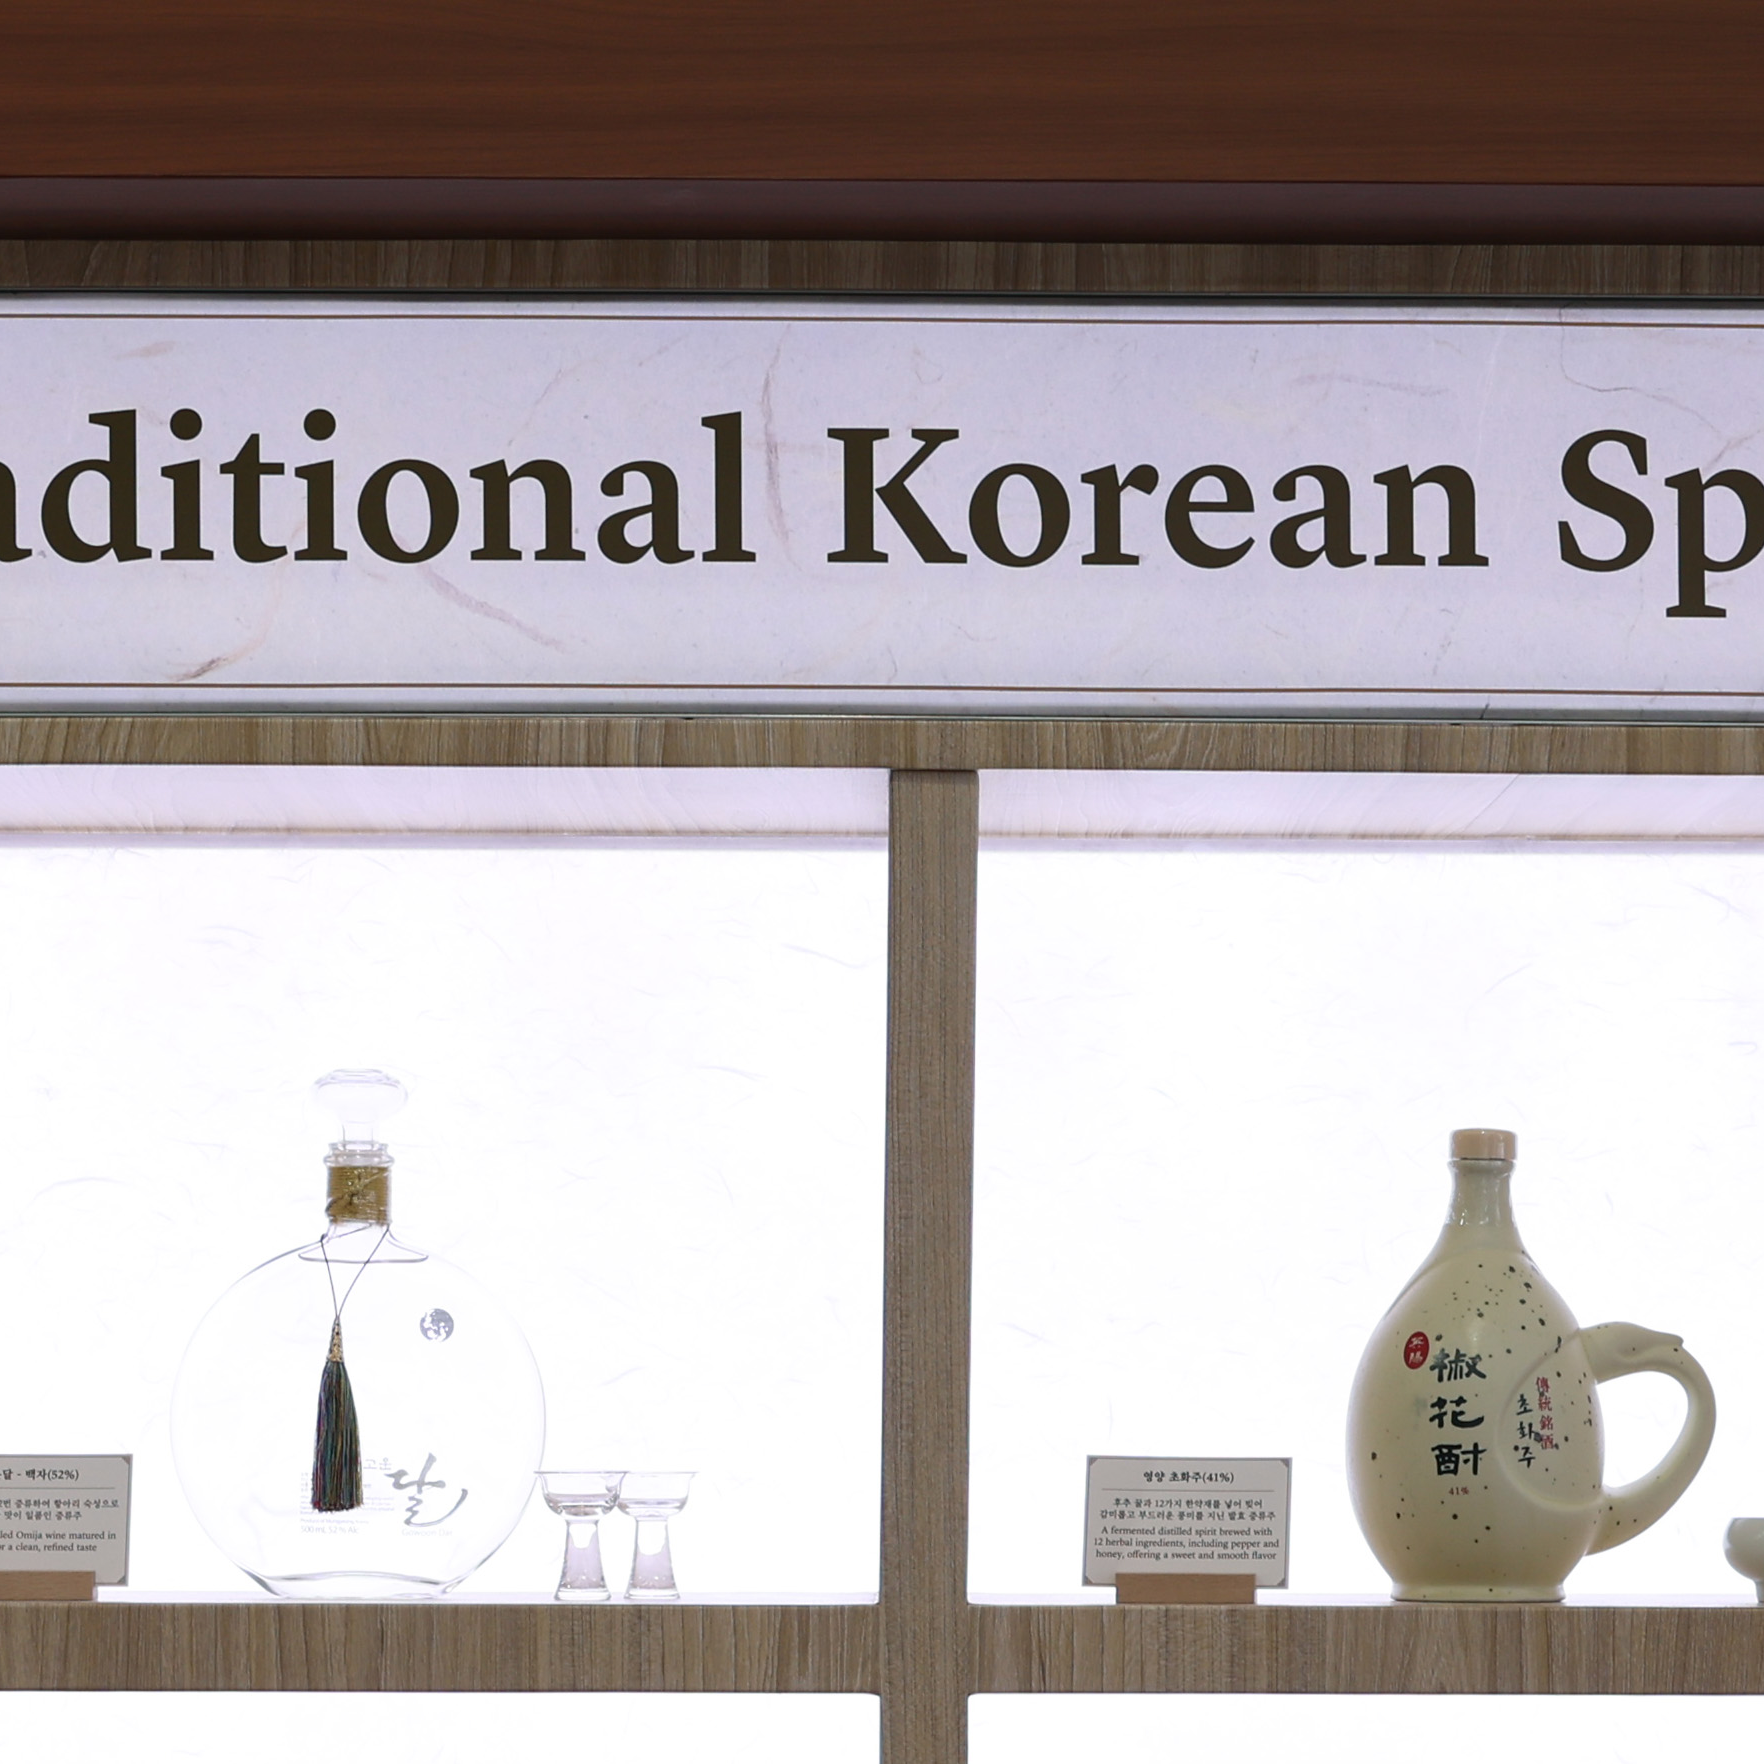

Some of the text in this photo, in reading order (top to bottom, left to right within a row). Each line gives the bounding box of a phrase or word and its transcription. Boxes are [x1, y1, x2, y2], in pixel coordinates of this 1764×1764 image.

[828, 428, 1488, 568] Korean
[1516, 1392, 1536, 1469] 초화주
[1143, 1470, 1165, 1483] 영양
[385, 1452, 468, 1527] 달
[1448, 1486, 1470, 1496] 41%
[15, 1530, 42, 1541] Omija
[68, 1530, 105, 1540] matured
[107, 1531, 116, 1540] in
[1110, 1525, 1155, 1535] fermented
[1157, 1526, 1192, 1536] distilled
[1194, 1526, 1216, 1538] spirit
[1219, 1526, 1251, 1536] brewed
[1253, 1526, 1272, 1536] with
